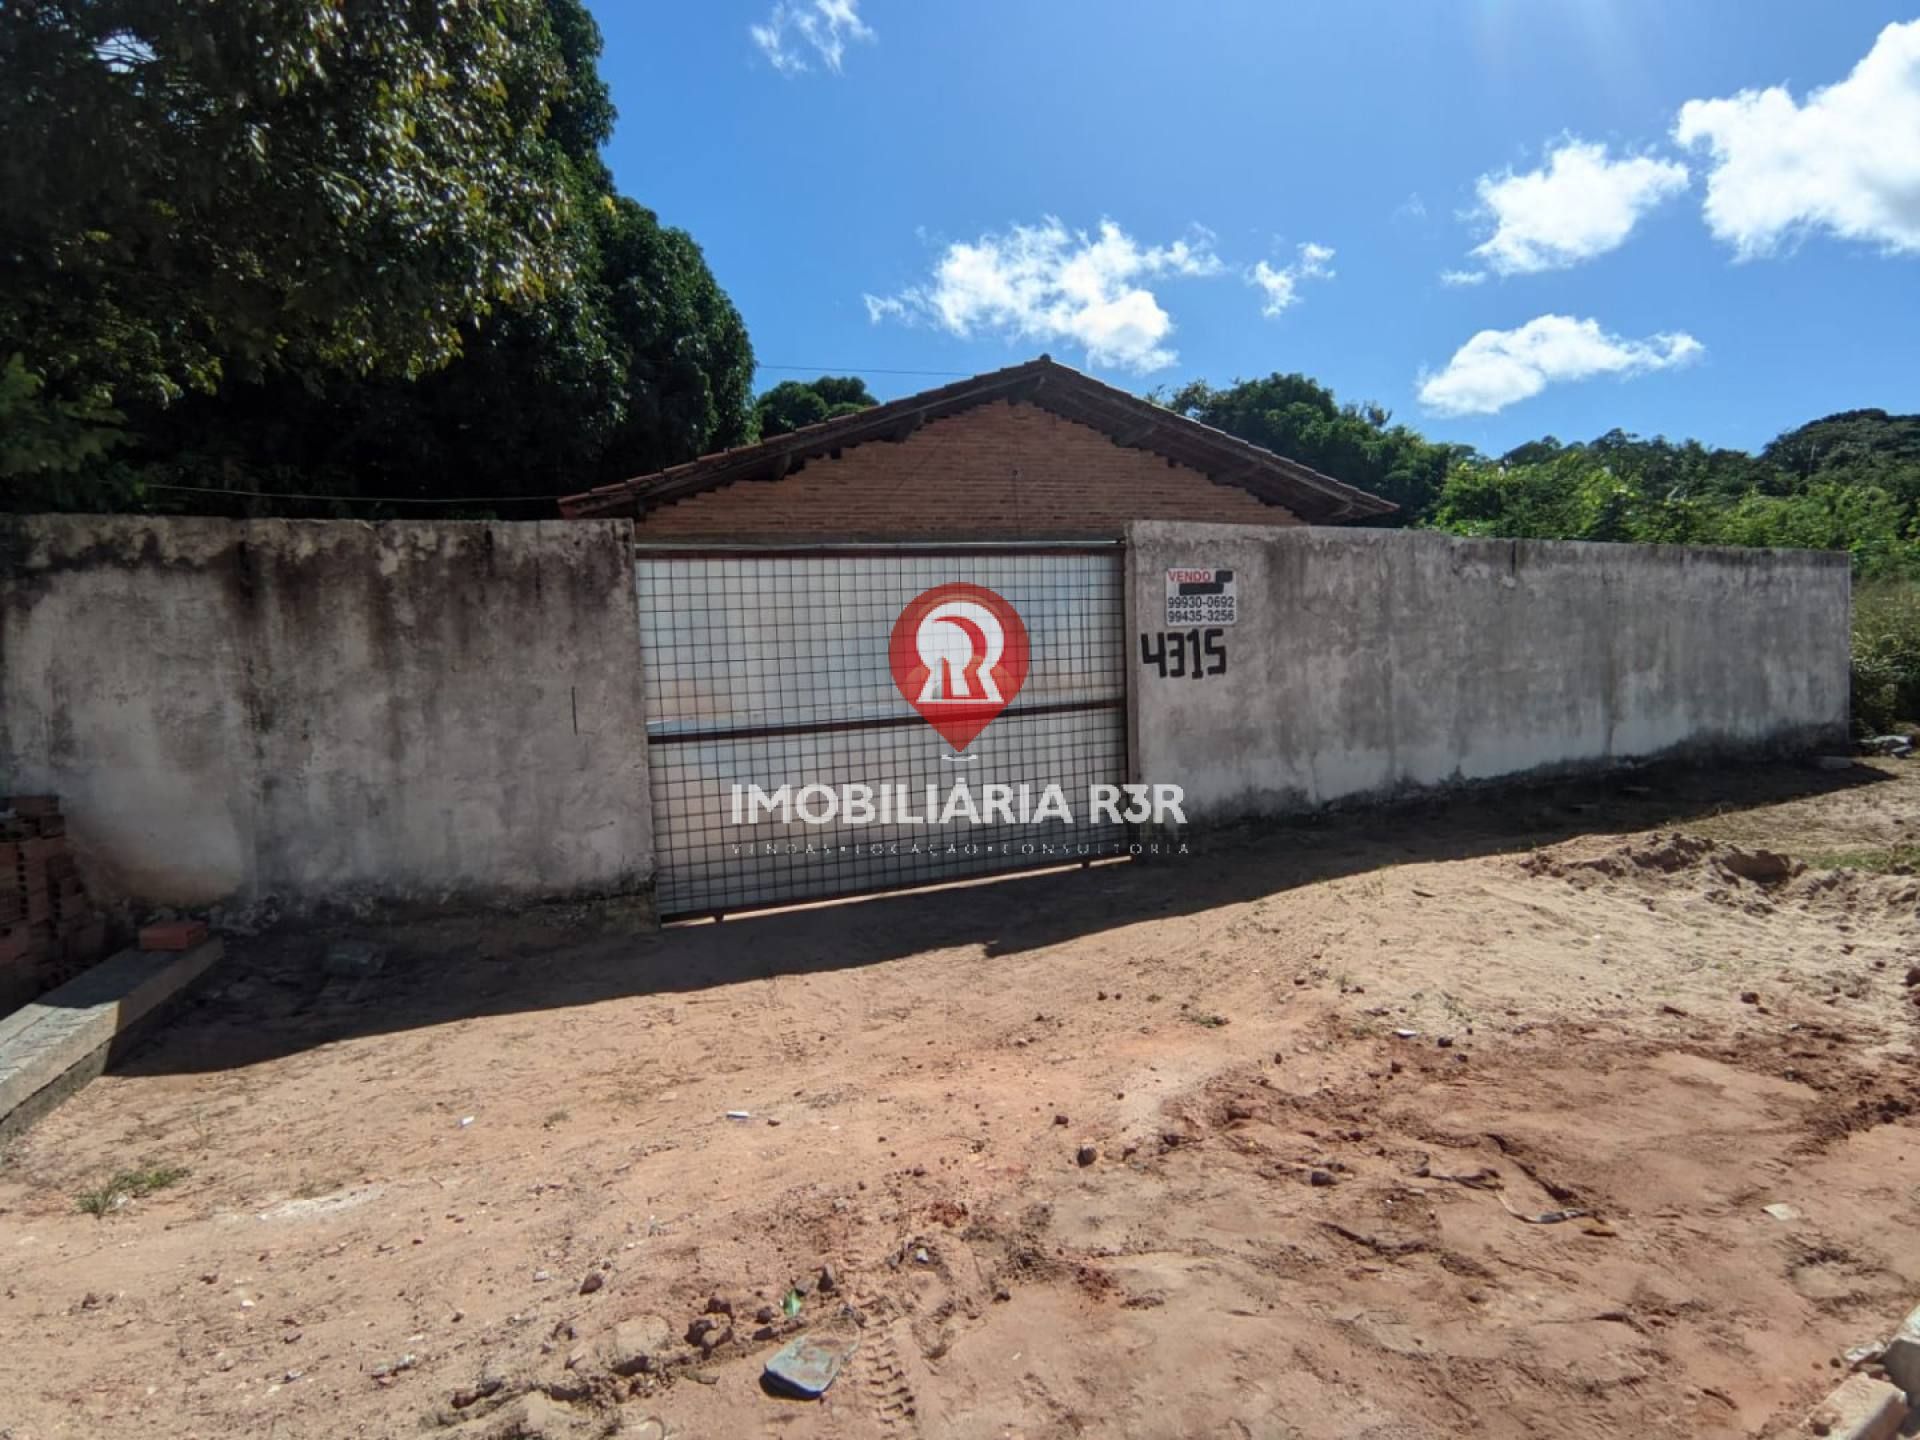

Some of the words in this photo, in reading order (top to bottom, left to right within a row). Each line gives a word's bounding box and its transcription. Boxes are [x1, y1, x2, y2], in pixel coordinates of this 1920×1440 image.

[1168, 570, 1211, 582] VENDO
[1168, 596, 1234, 608] 99930-0692
[1141, 628, 1226, 679] 4315
